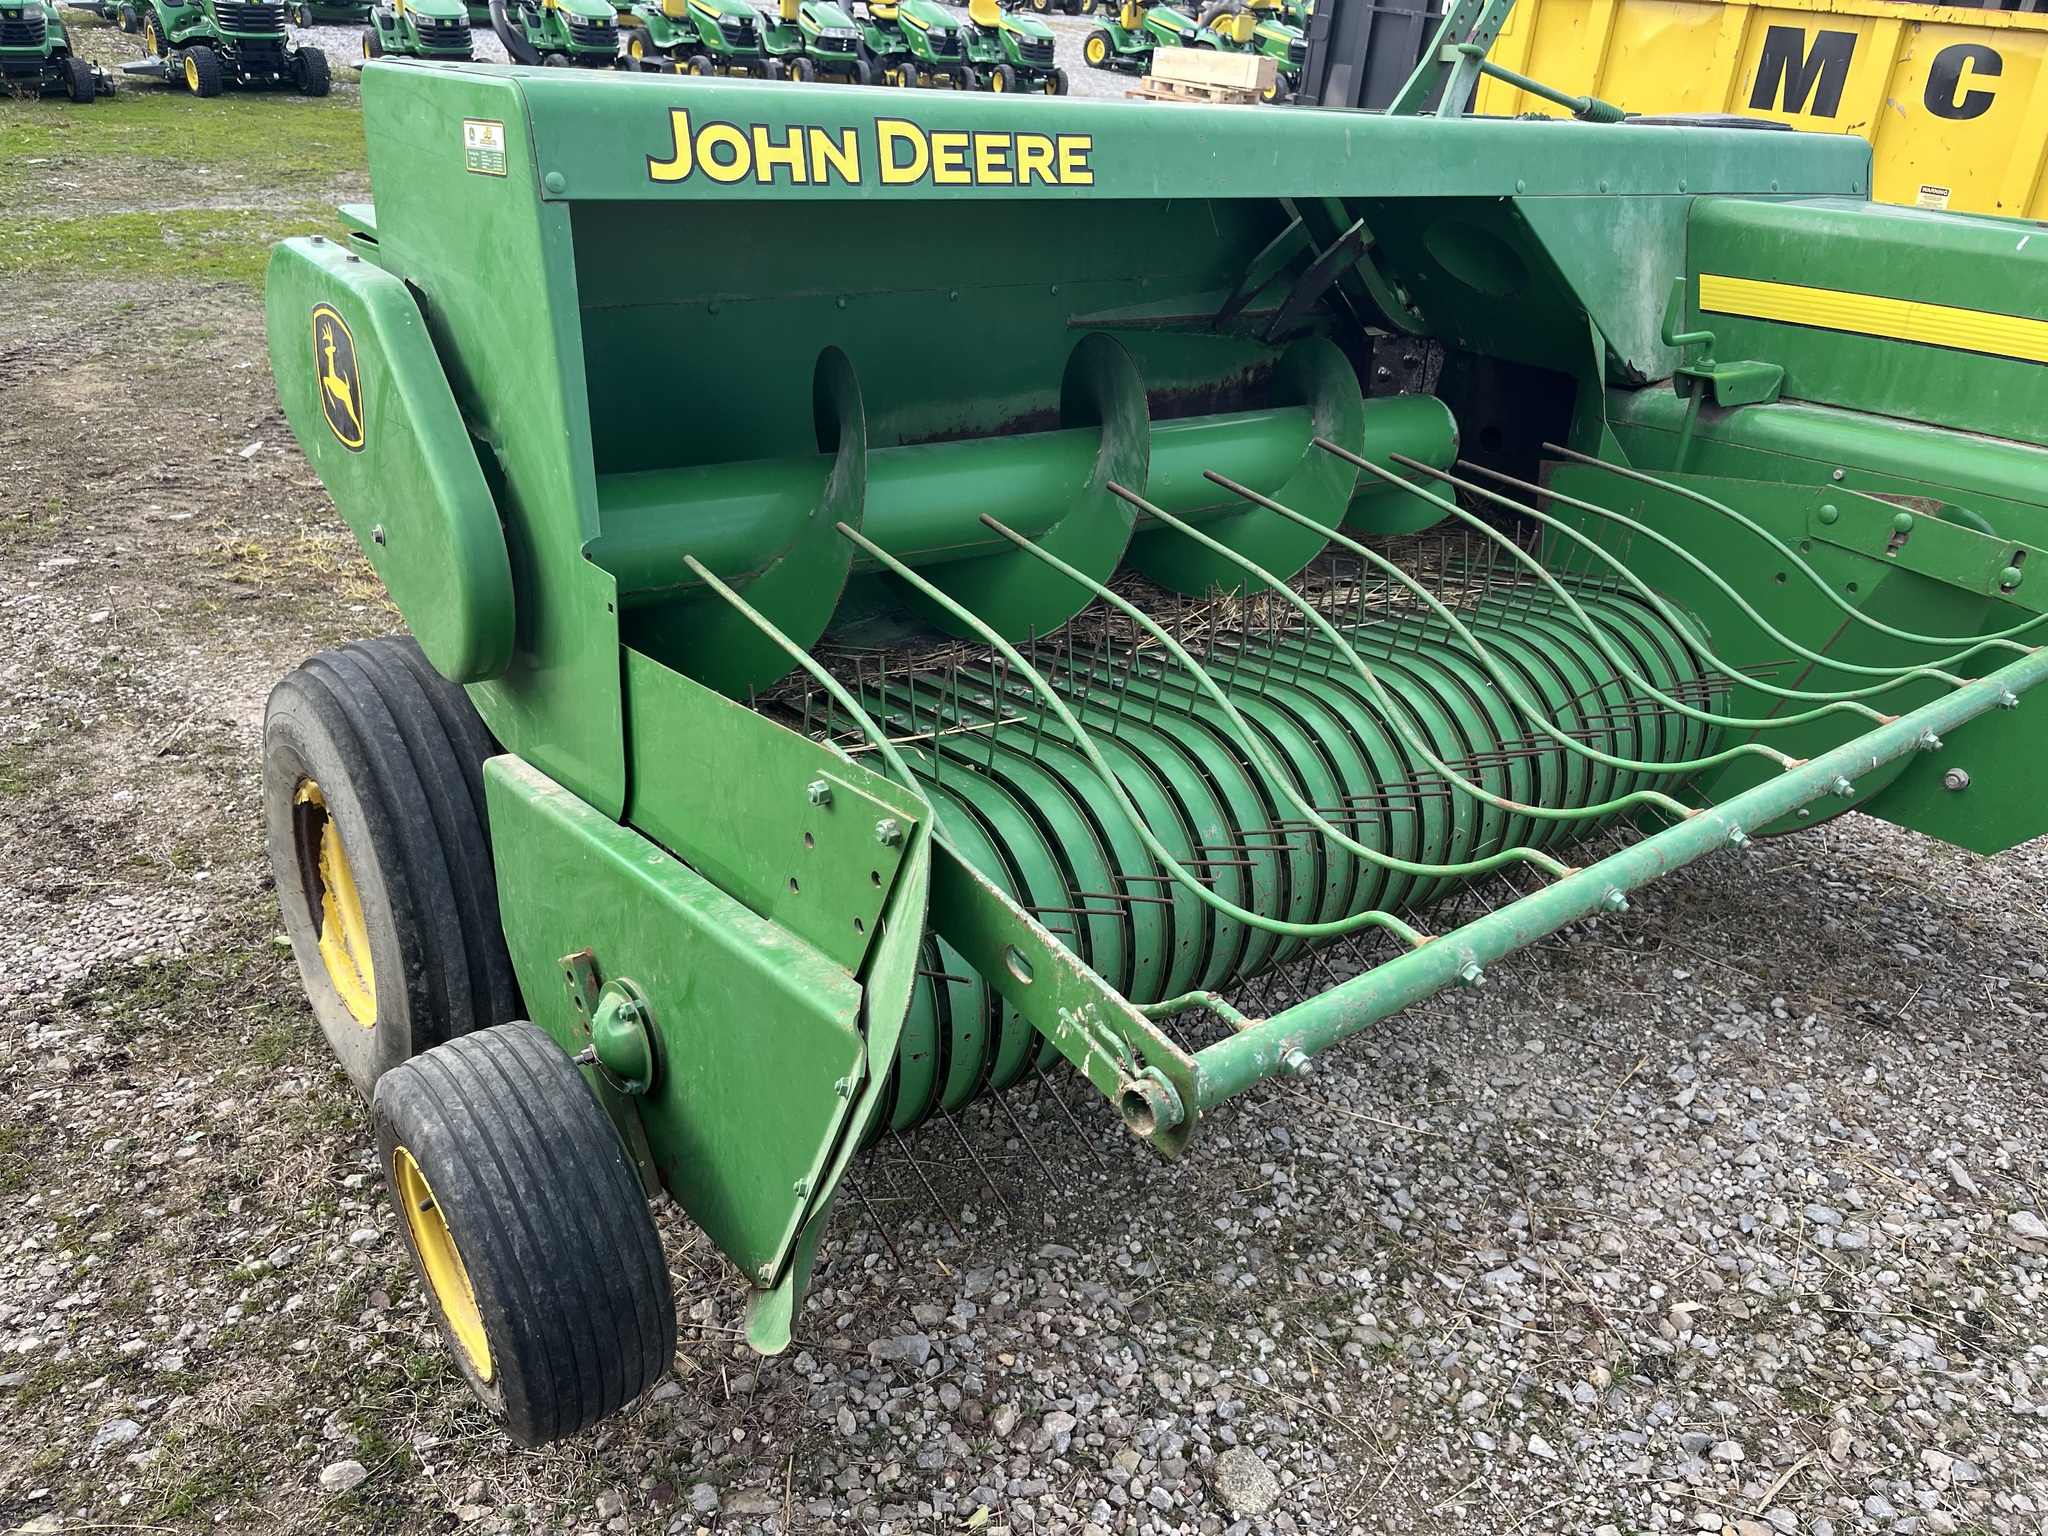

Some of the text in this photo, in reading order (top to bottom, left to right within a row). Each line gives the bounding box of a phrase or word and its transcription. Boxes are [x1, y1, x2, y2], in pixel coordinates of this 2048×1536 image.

[1749, 25, 2003, 120] M C
[647, 107, 1095, 187] JOHN DEERE
[1921, 186, 1948, 196] WARNING
